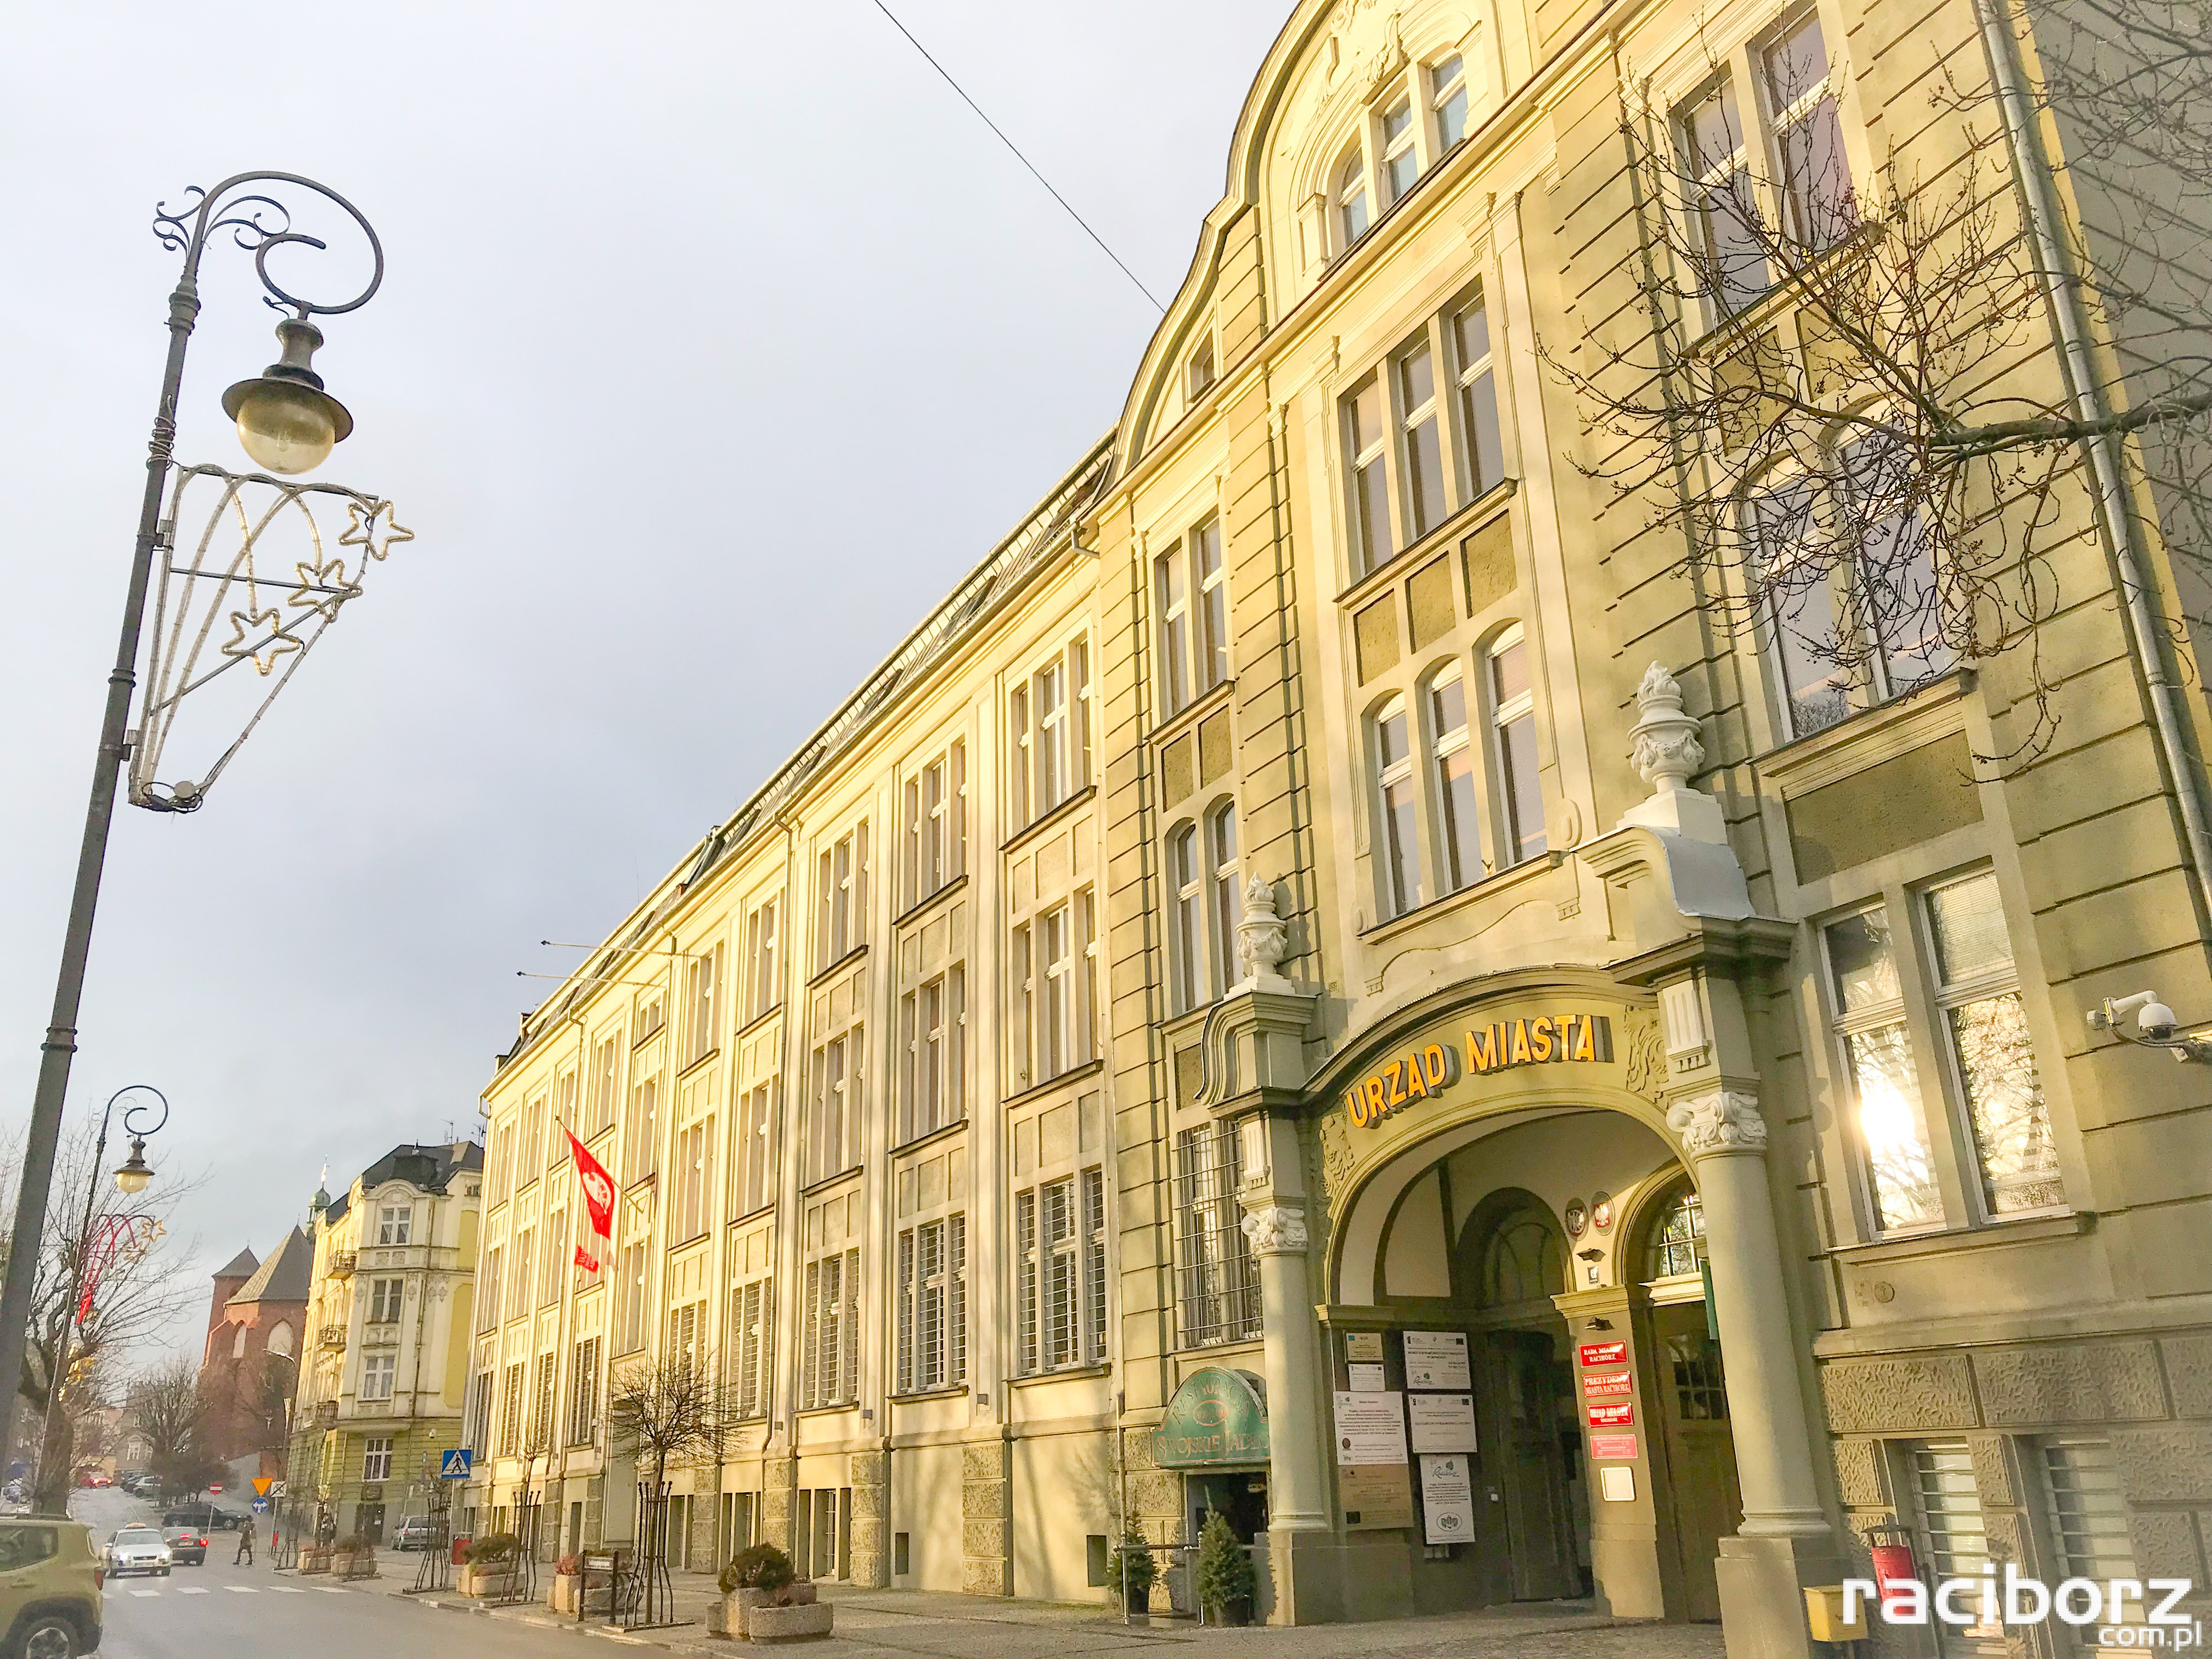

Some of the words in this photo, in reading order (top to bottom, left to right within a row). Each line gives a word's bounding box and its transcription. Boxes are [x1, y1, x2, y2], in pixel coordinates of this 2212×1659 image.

[1465, 1014, 1596, 1074] MIASTA
[1172, 1375, 1250, 1432] RESTAURACJA
[1585, 1385, 1604, 1394] MIASTA
